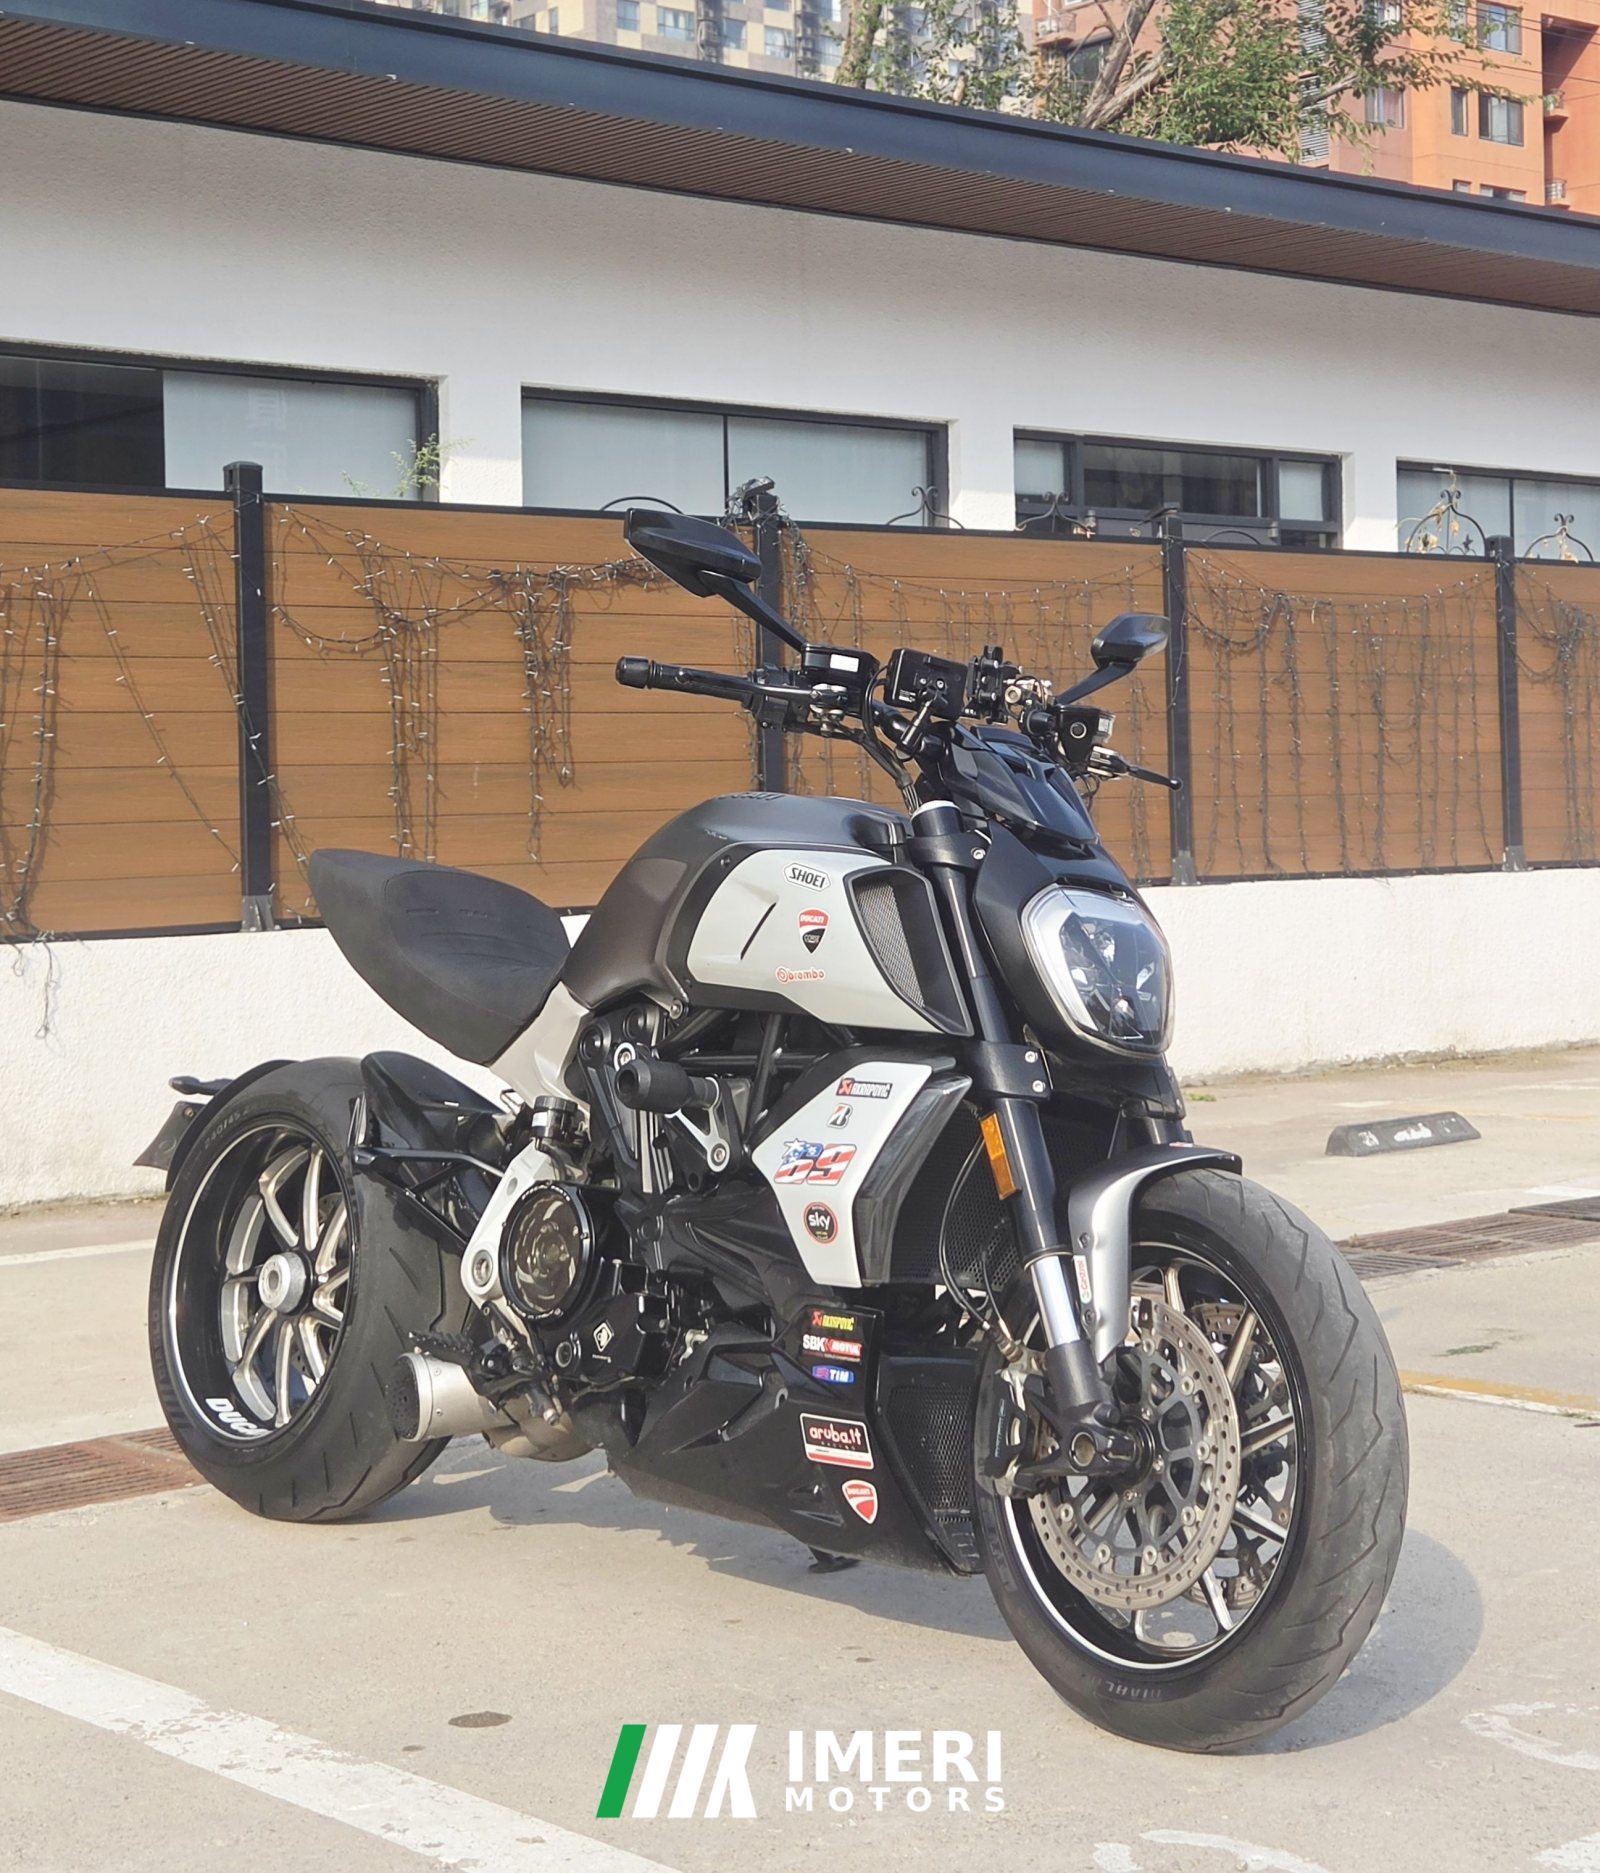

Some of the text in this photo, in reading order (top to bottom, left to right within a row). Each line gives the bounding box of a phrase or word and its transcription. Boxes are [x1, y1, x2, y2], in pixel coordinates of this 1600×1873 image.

[788, 867, 825, 888] SHOEI
[785, 969, 825, 981] brembo
[808, 1211, 831, 1231] sky
[803, 1334, 826, 1352] SBK
[829, 1369, 849, 1382] TIM
